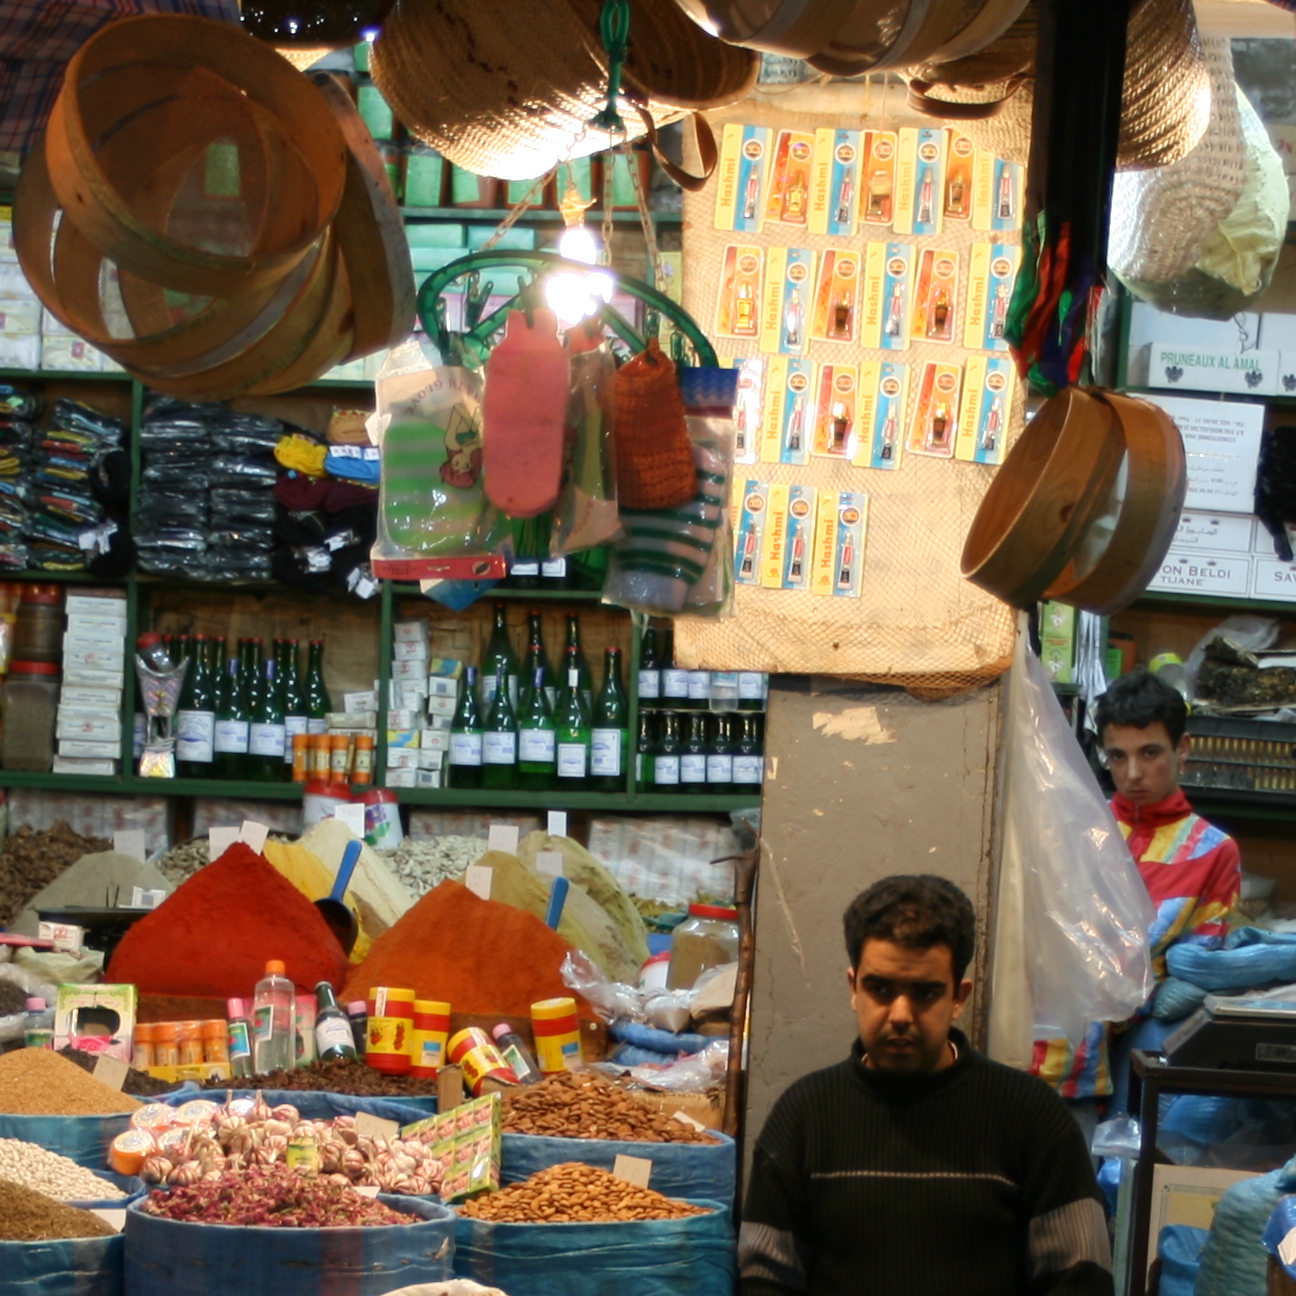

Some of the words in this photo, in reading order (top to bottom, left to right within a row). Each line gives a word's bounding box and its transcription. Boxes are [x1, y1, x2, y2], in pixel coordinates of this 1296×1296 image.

[720, 157, 737, 207] Hashmi
[814, 161, 829, 211] Hashmi
[898, 161, 912, 211] Hashmi
[977, 157, 990, 207] Hashmi
[765, 281, 781, 331] Hashmi
[866, 276, 881, 326] Hashmi
[970, 276, 985, 326] Hashmi
[1160, 352, 1216, 369] PRUNEAUX
[1217, 357, 1232, 369] AL
[1234, 358, 1261, 371] AMAL
[404, 379, 443, 417] GLOVE
[766, 390, 782, 440] Hashmi
[858, 394, 874, 444] Hashmi
[962, 388, 979, 438] Hashmi
[769, 511, 784, 560] Hashmi
[820, 519, 835, 568] Hashmi
[1161, 576, 1204, 587] TIJANE
[1189, 566, 1231, 579] BELDI
